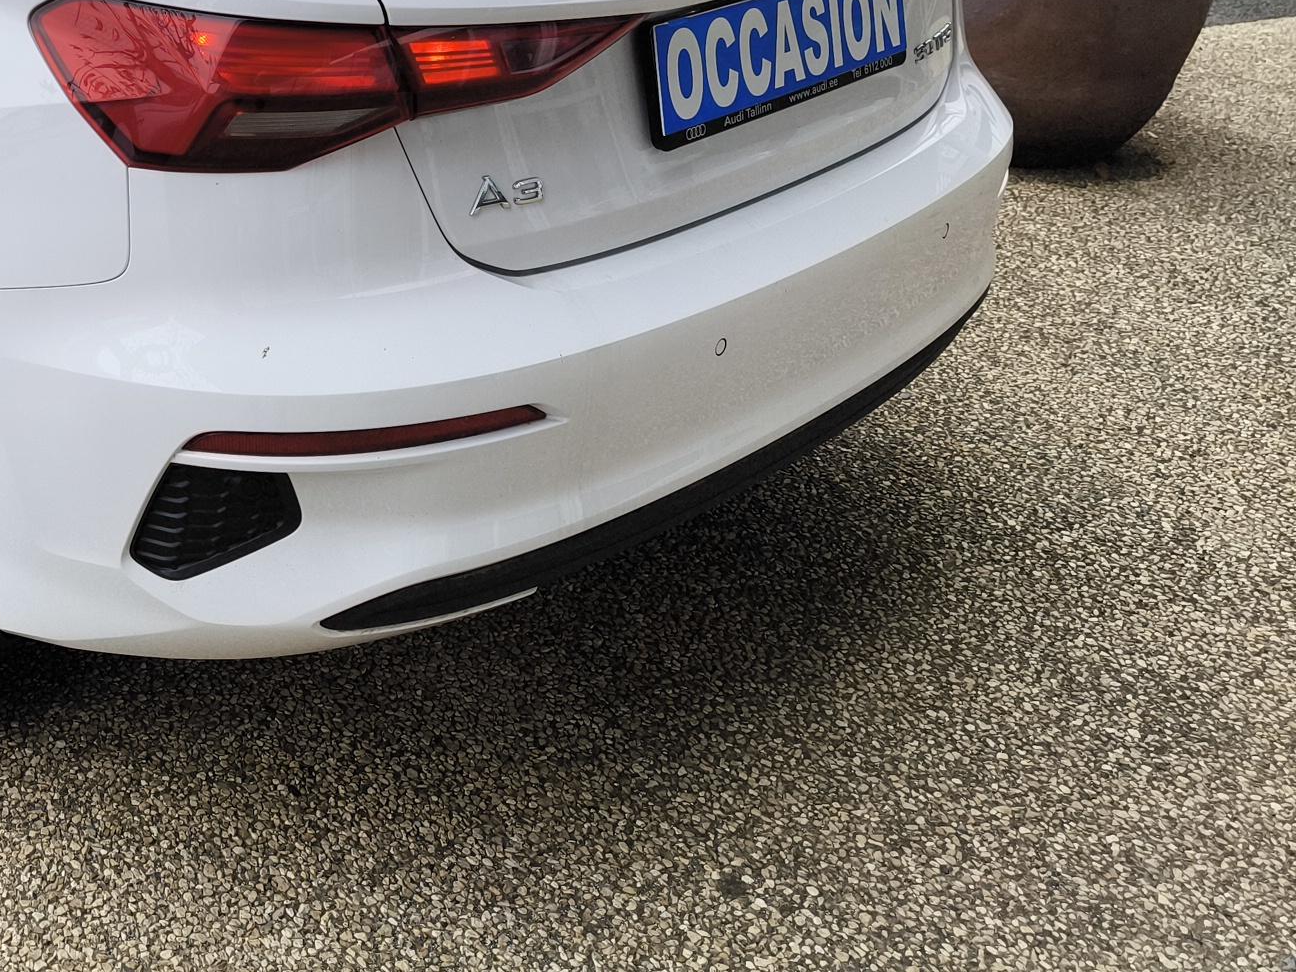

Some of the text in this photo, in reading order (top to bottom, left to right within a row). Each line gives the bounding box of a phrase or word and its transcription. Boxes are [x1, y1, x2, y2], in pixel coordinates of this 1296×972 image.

[723, 110, 744, 128] Audi
[745, 101, 773, 120] Tallinn
[469, 174, 544, 217] A3
